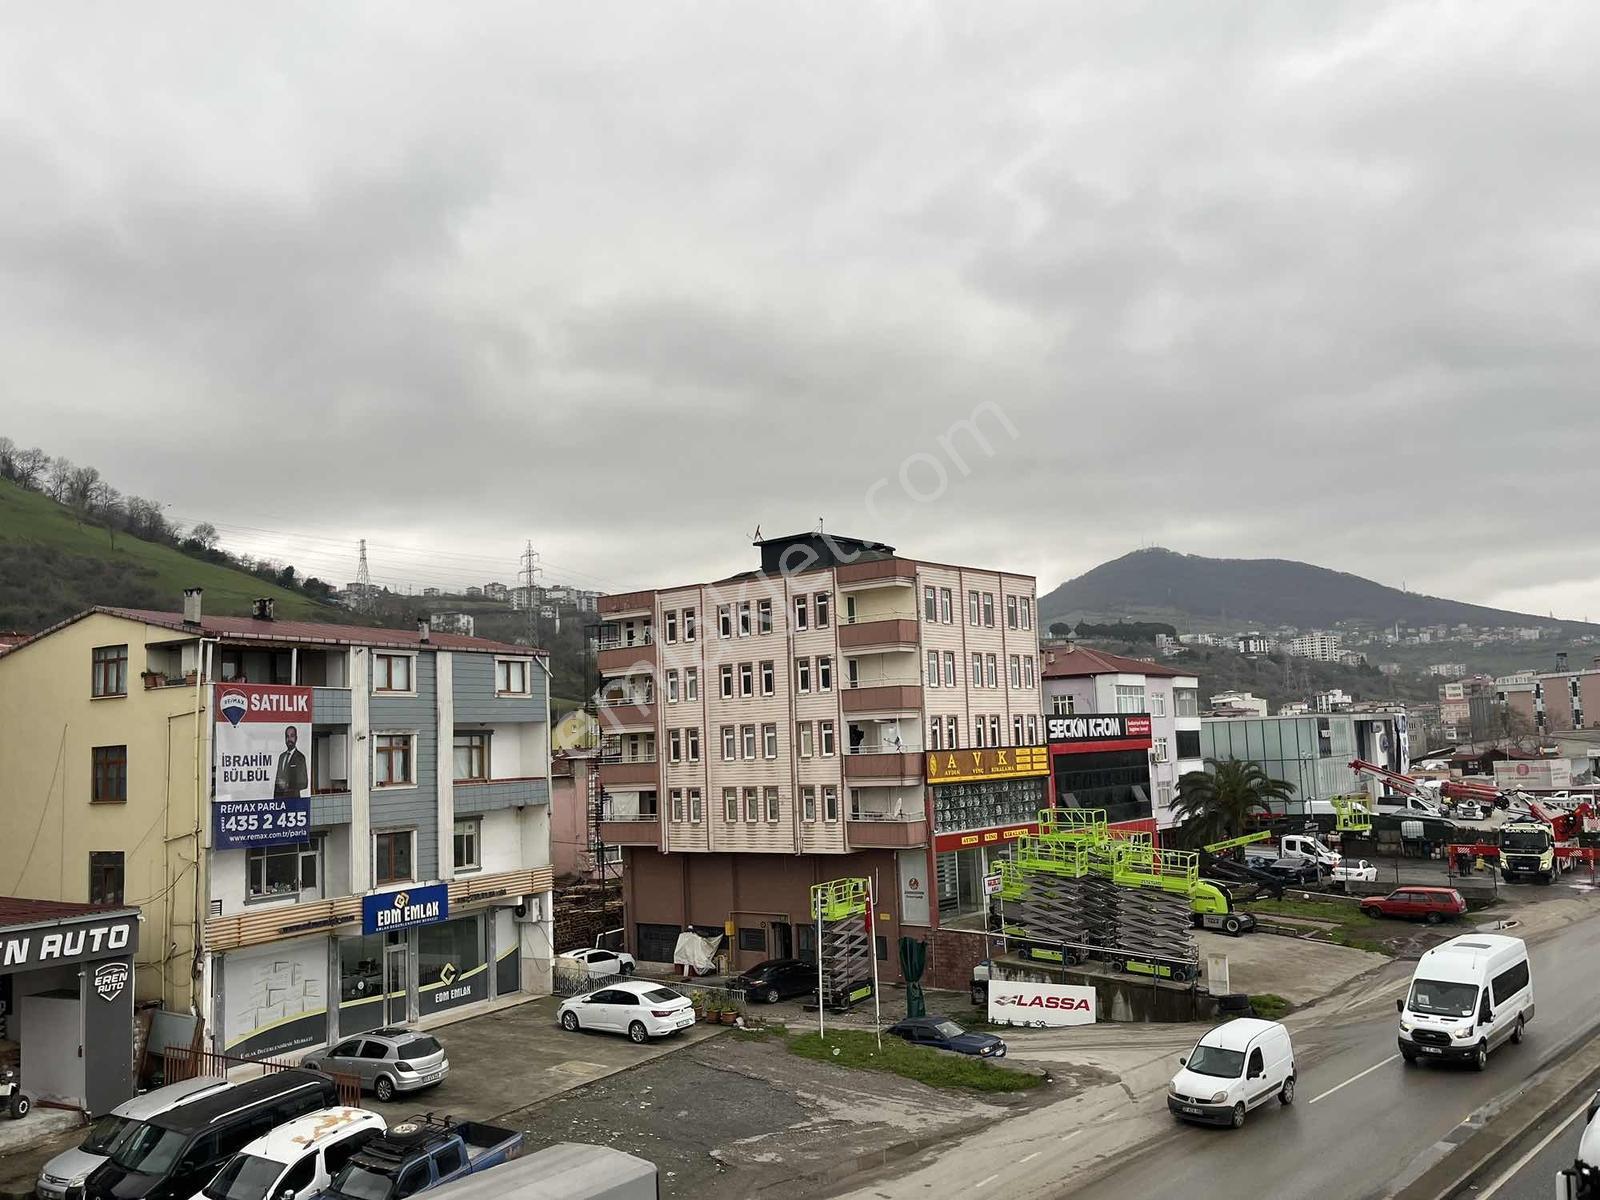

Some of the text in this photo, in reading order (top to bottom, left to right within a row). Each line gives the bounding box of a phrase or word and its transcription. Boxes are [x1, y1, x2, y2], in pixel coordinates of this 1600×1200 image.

[251, 693, 308, 712] SATILIK
[1088, 718, 1121, 737] KROM
[221, 752, 272, 768] İBRAHİM
[947, 753, 957, 768] A
[972, 752, 982, 767] V
[997, 750, 1007, 765] K
[223, 767, 270, 782] BÜLBÜL
[220, 801, 286, 814] RE/MAX PARLA
[225, 815, 258, 831] 435
[262, 814, 272, 830] 2
[277, 811, 307, 828] 435
[377, 909, 401, 927] EDM
[405, 901, 439, 922] EMLAK
[39, 924, 130, 960] AUTO
[94, 972, 128, 986] EREN
[97, 982, 124, 994] AUTO
[435, 985, 471, 1003] EDM EMLAK
[1016, 994, 1090, 1012] LASSA
